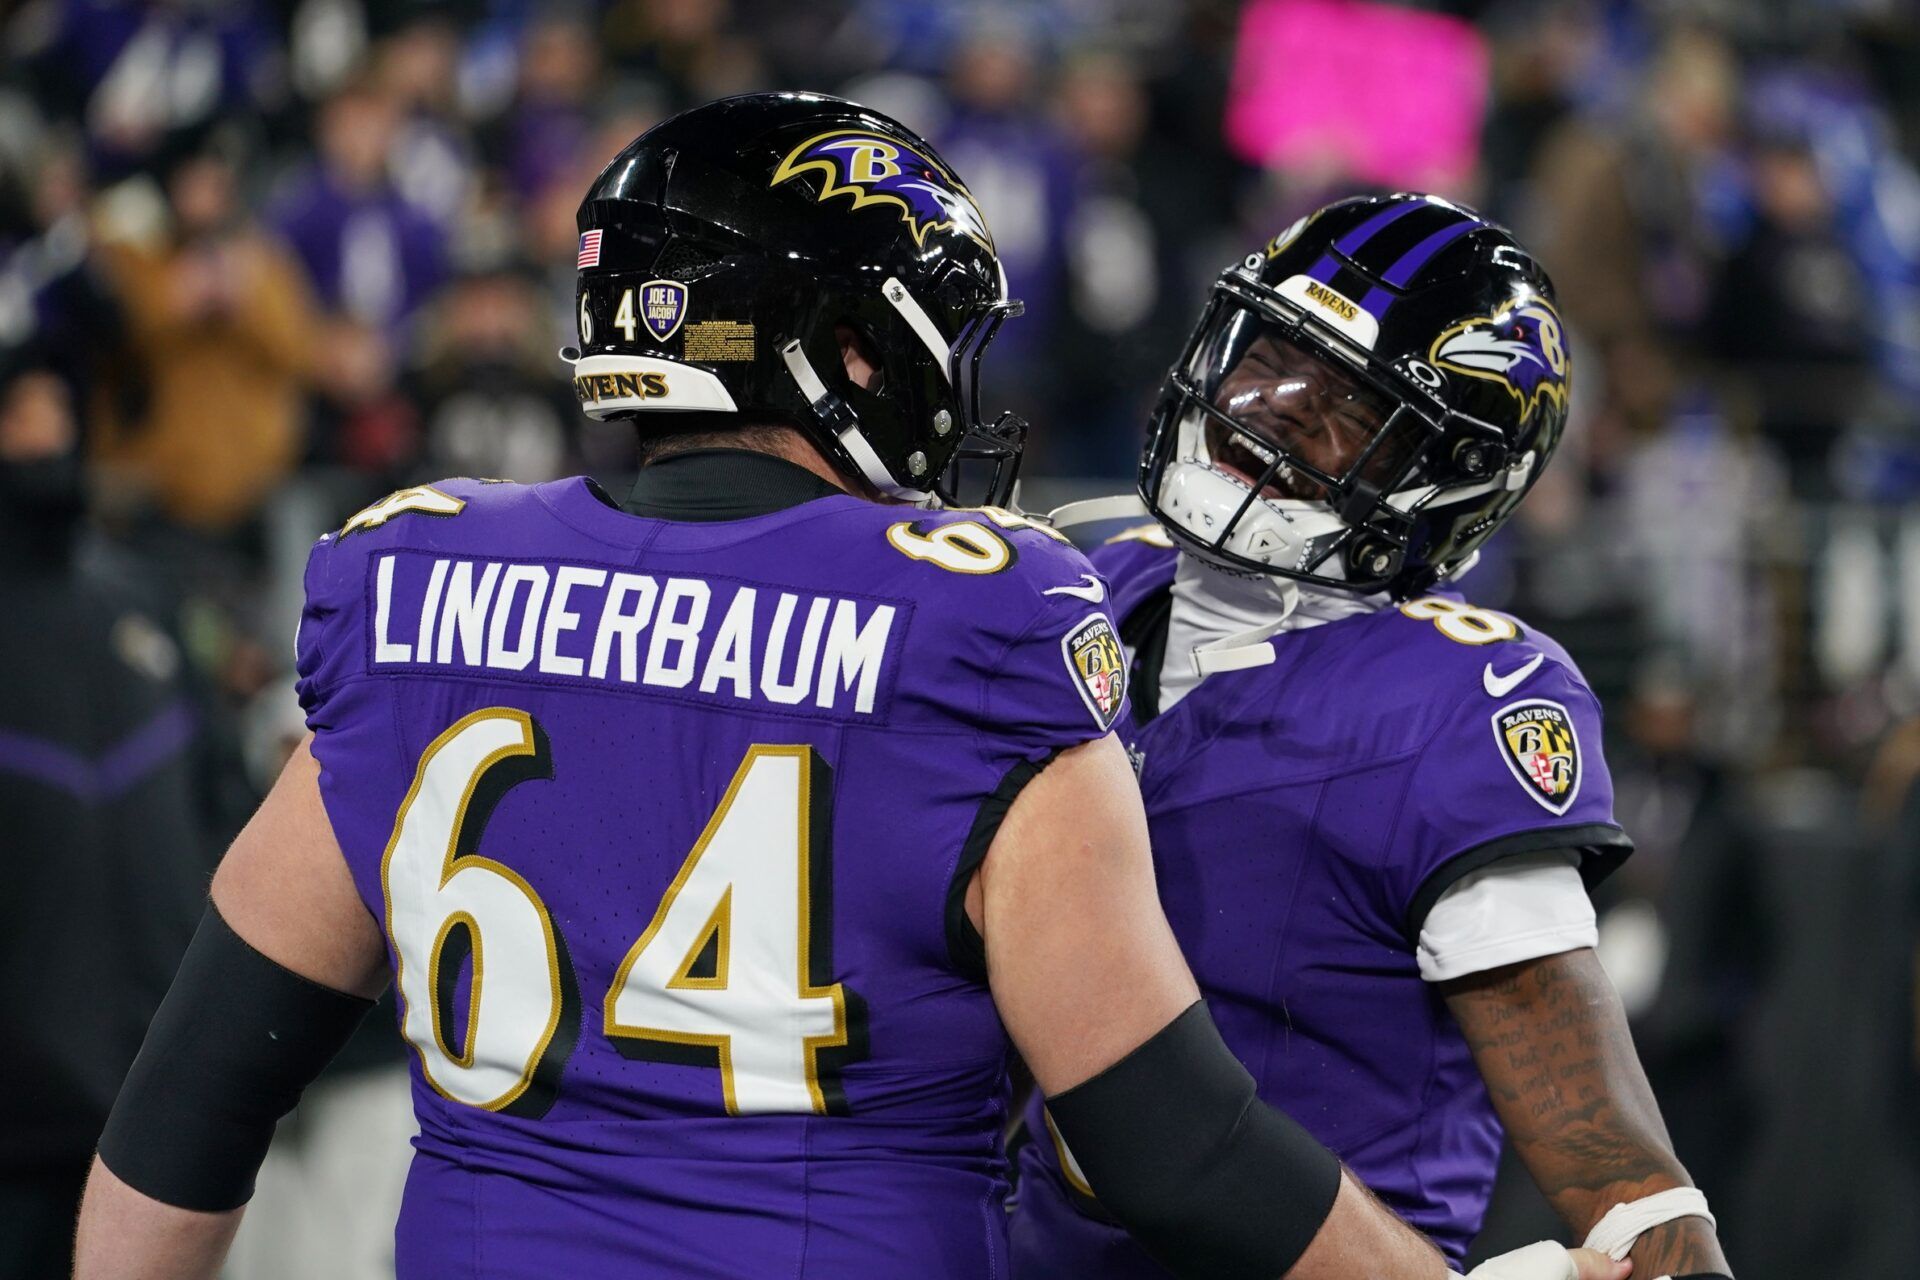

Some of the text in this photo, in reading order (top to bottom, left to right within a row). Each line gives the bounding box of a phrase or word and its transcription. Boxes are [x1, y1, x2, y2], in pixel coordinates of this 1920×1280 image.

[648, 287, 678, 306] JOE D.
[1304, 281, 1359, 321] RAVENS
[648, 306, 677, 320] JACOBY
[374, 554, 896, 714] LINDERBAUM
[1071, 622, 1109, 651] RAVENS
[1502, 708, 1562, 729] RAVENS
[381, 706, 862, 1117] 64
